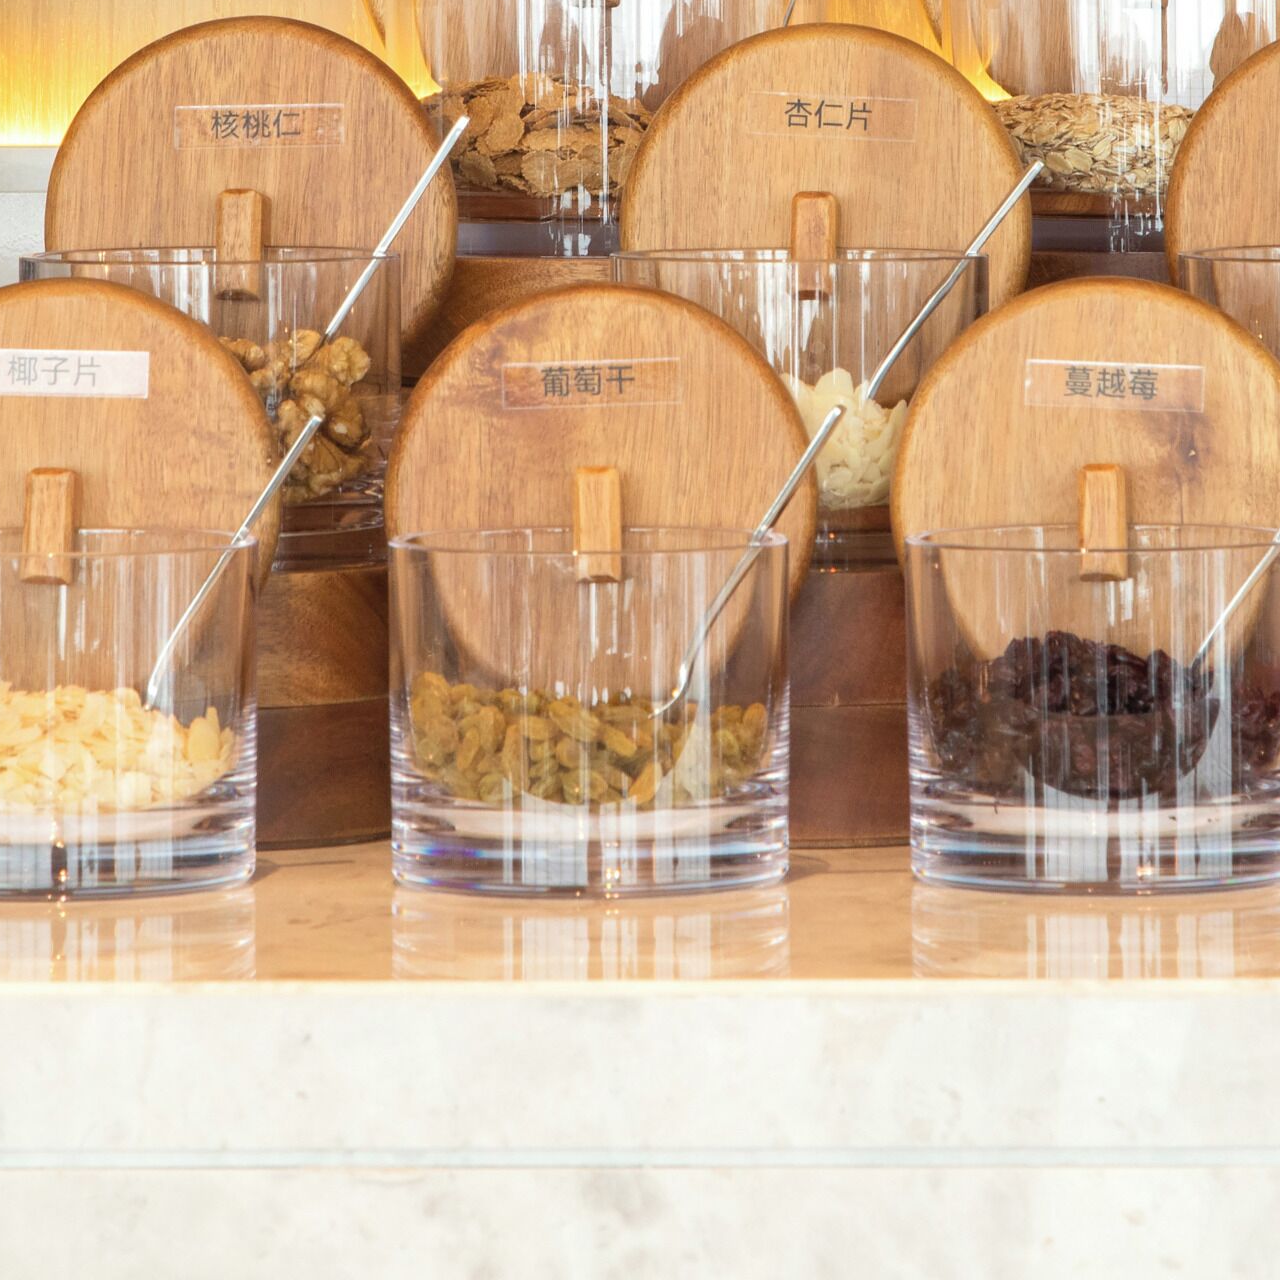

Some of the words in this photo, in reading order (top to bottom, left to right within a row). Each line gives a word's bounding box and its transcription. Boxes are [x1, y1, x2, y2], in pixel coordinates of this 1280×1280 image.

[211, 109, 301, 140] 核桃仁
[784, 98, 873, 132] 杏仁片
[8, 354, 102, 387] 椰子片
[541, 365, 635, 398] 葡萄干
[1064, 365, 1159, 400] 蔓越莓
